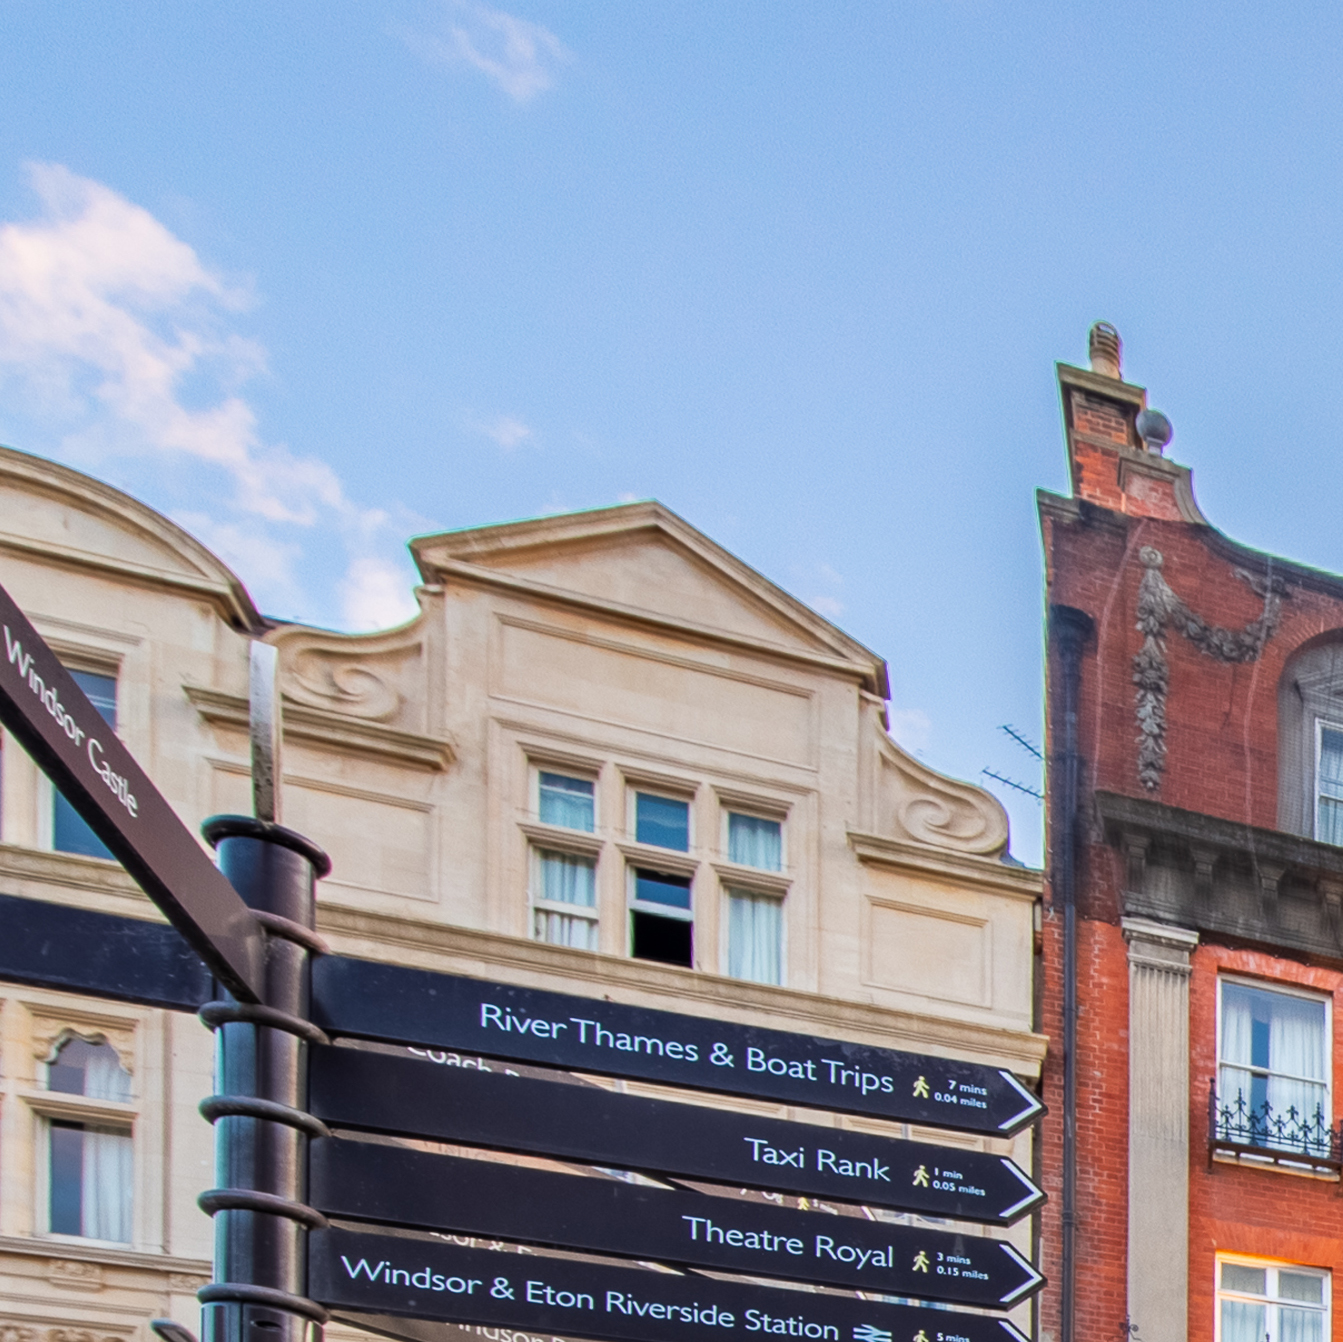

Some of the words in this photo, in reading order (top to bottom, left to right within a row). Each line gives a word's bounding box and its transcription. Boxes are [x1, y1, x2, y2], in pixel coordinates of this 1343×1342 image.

[4, 624, 85, 746] Windsor
[88, 738, 138, 818] Castle
[480, 1003, 568, 1040] River
[570, 1017, 699, 1062] Thames
[709, 1042, 735, 1067] &
[746, 1047, 818, 1082] Boat
[821, 1059, 894, 1095] Trips
[948, 1079, 957, 1090] 7
[959, 1084, 987, 1096] mins
[934, 1091, 958, 1104] 0.04
[960, 1097, 987, 1109] miles
[743, 1137, 805, 1168] Taxi
[816, 1149, 892, 1182] Rank
[942, 1170, 963, 1180] min
[932, 1180, 956, 1192] 0.05
[958, 1186, 986, 1197] miles
[682, 1215, 804, 1256] Theatre
[815, 1235, 894, 1270] Royal
[936, 1251, 944, 1261] 3
[946, 1255, 971, 1265] mins
[936, 1265, 959, 1277] 0.15
[961, 1270, 989, 1280] miles
[341, 1255, 484, 1295] Windsor
[490, 1277, 515, 1301] &
[525, 1280, 595, 1310] Eton
[605, 1291, 735, 1329] Riverside
[744, 1309, 839, 1342] Station
[937, 1332, 944, 1342] 5
